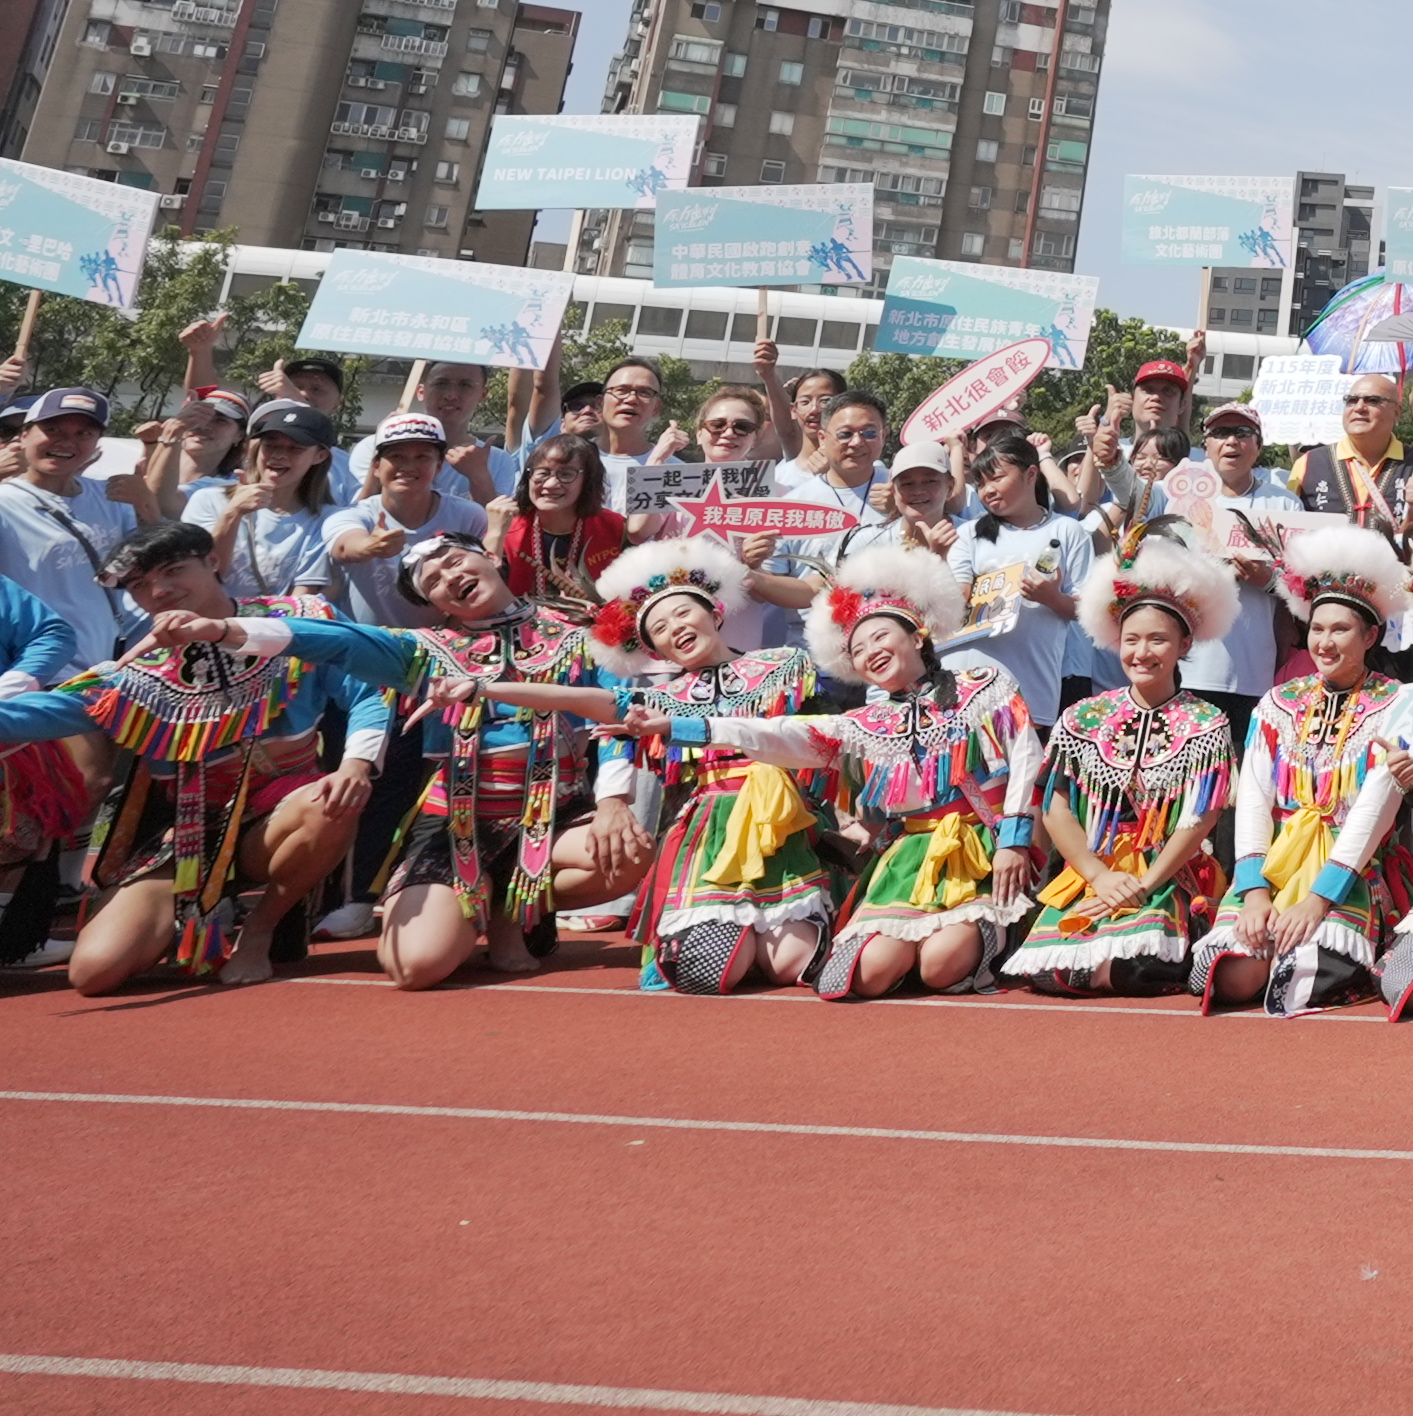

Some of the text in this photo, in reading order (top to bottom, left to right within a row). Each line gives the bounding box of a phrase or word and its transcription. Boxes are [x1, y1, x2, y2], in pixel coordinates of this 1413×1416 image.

[493, 167, 637, 181] NEW TAIPEI LION
[1155, 243, 1223, 260] 文化藝術團
[670, 259, 812, 280] 體育文化教育協會
[348, 306, 472, 333] 新北市永和區
[888, 309, 1042, 338] 新北市原住民族青年
[309, 323, 495, 356] 原住民族發展協進會
[892, 328, 1014, 354] 地方創生發展協
[1264, 359, 1334, 376] 115年度
[702, 505, 847, 530] 我是原民我驕傲
[587, 546, 620, 566] NTPC
